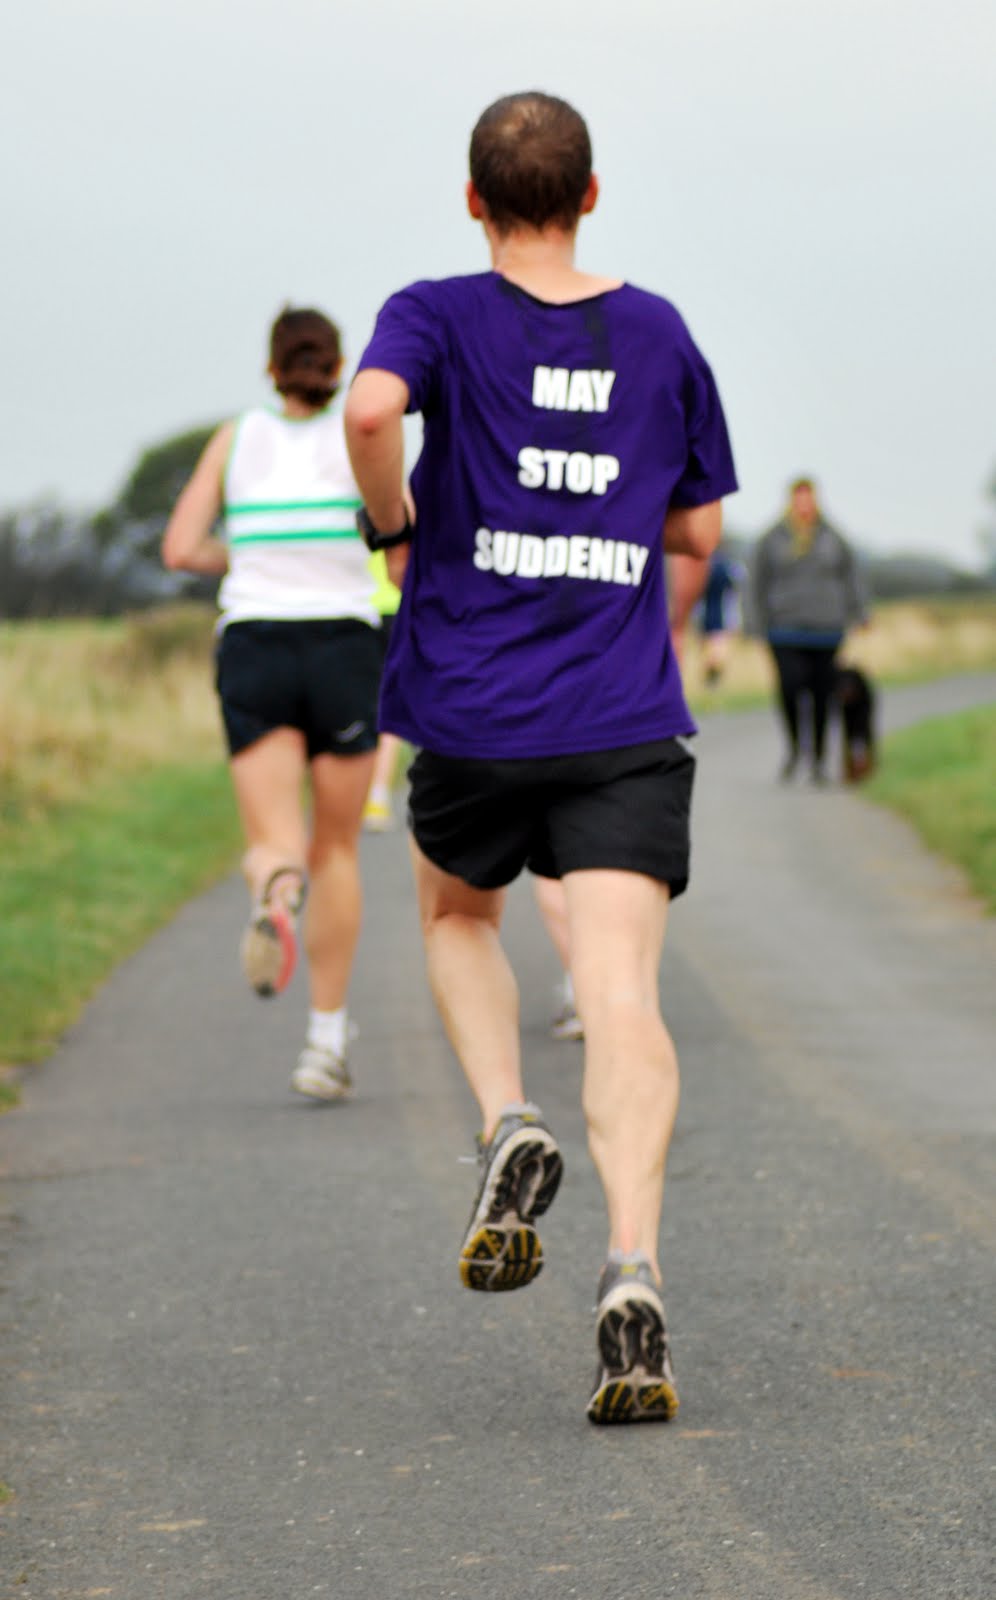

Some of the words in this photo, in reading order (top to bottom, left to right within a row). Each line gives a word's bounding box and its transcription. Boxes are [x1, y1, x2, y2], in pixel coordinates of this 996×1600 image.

[532, 365, 616, 413] MAY
[517, 446, 620, 496] STOP
[473, 527, 649, 587] SUDDENLY
